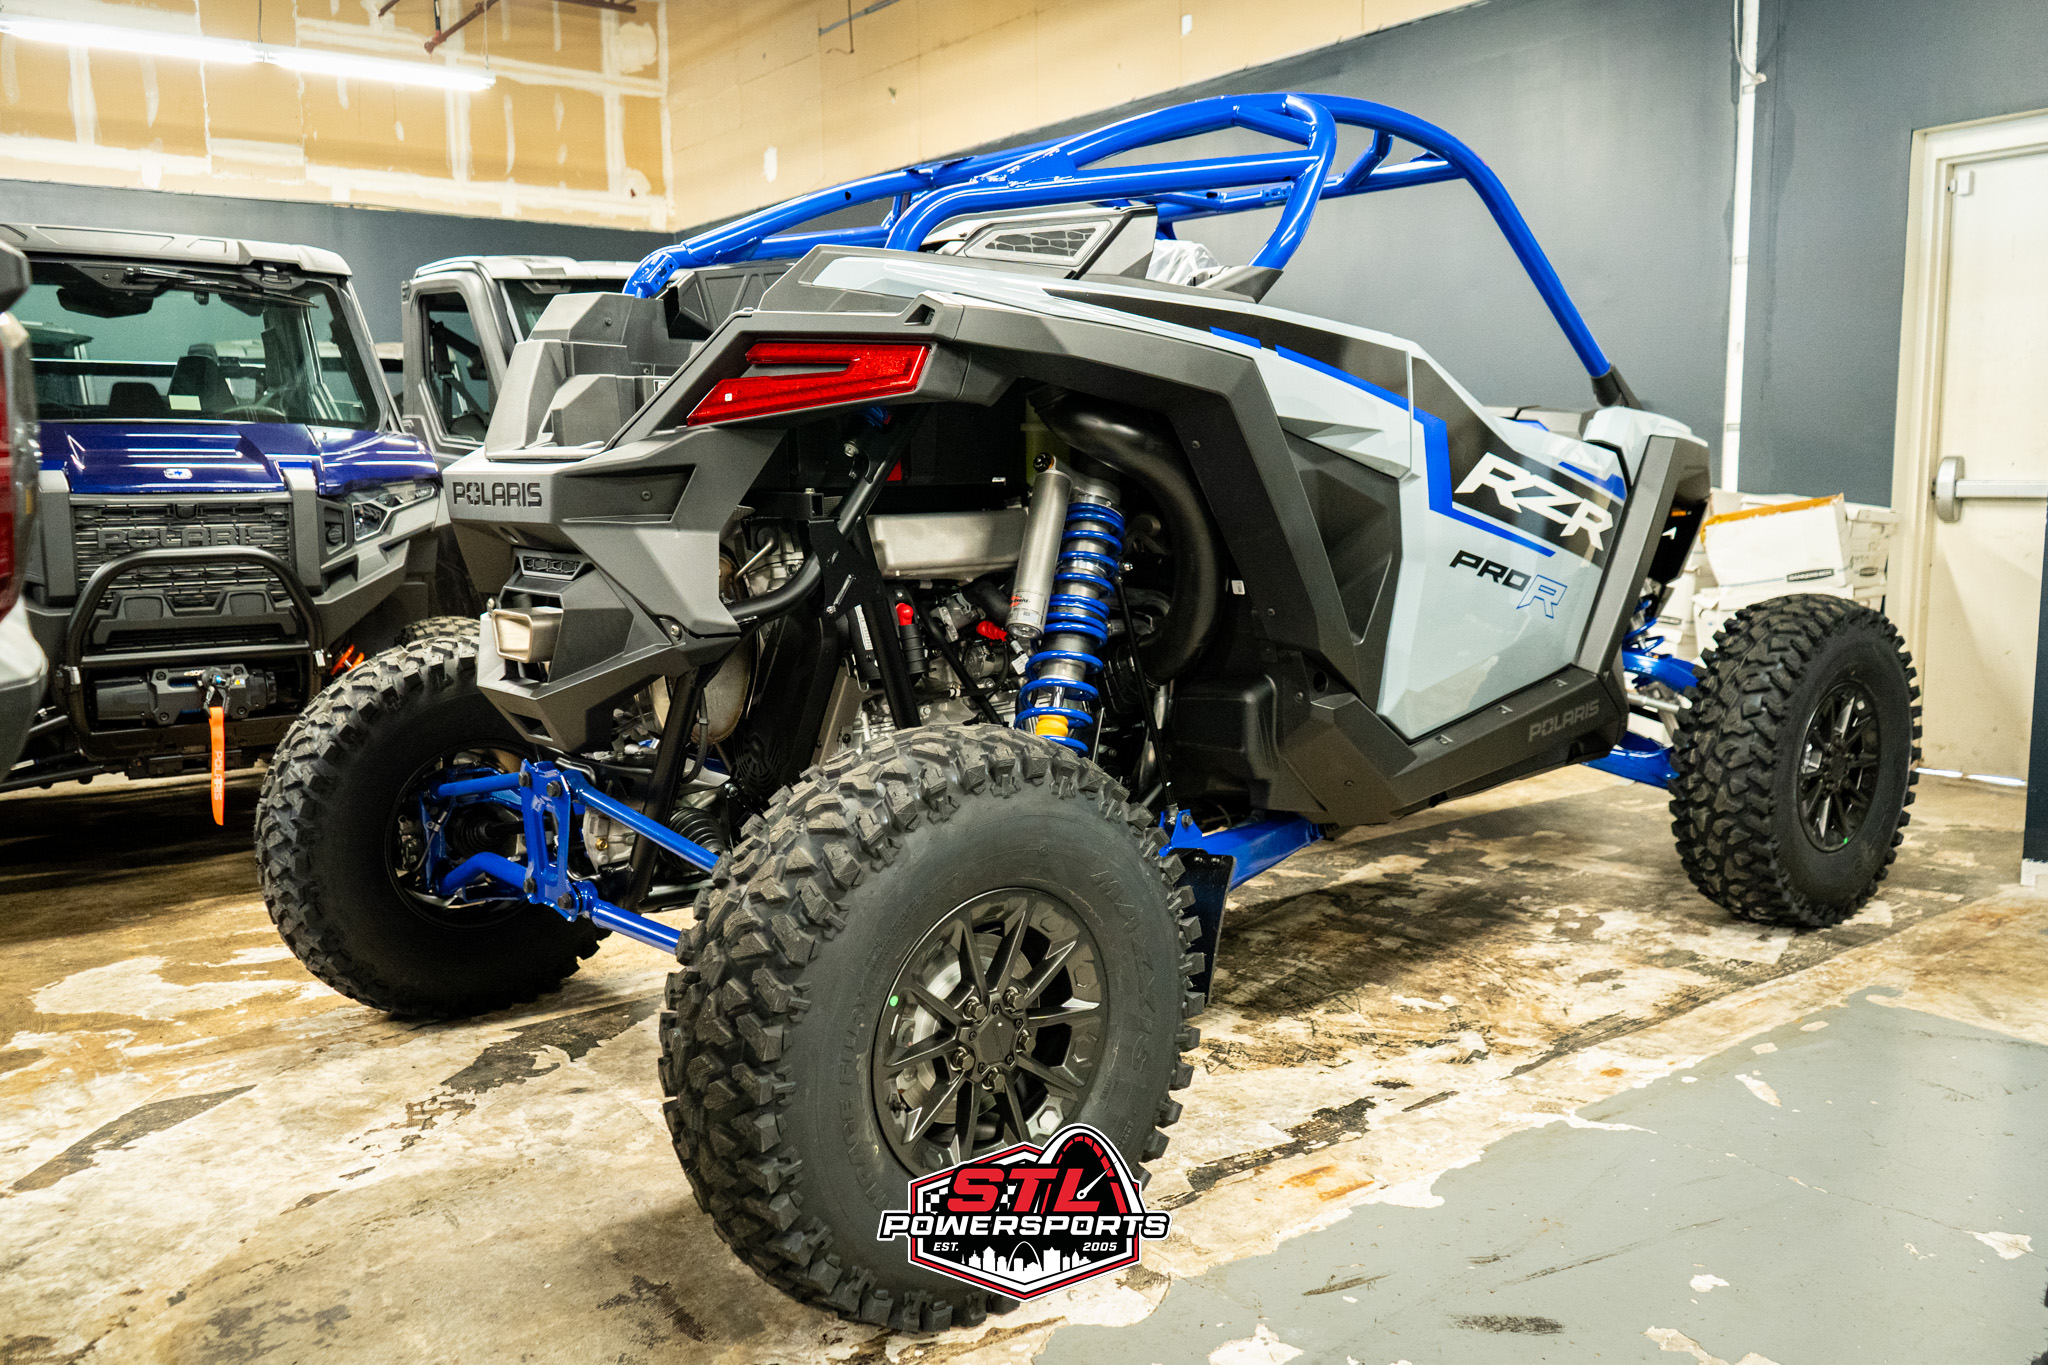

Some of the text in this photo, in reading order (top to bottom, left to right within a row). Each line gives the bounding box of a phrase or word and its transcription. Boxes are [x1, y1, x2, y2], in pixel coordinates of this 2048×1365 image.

[453, 482, 543, 507] POLARIS
[1454, 452, 1614, 551] RZR
[97, 526, 274, 549] POLARIS
[1449, 550, 1568, 619] PRO R
[1527, 699, 1600, 742] POLARIS
[213, 750, 223, 801] POLARIS
[1090, 869, 1155, 1073] MAXXIS
